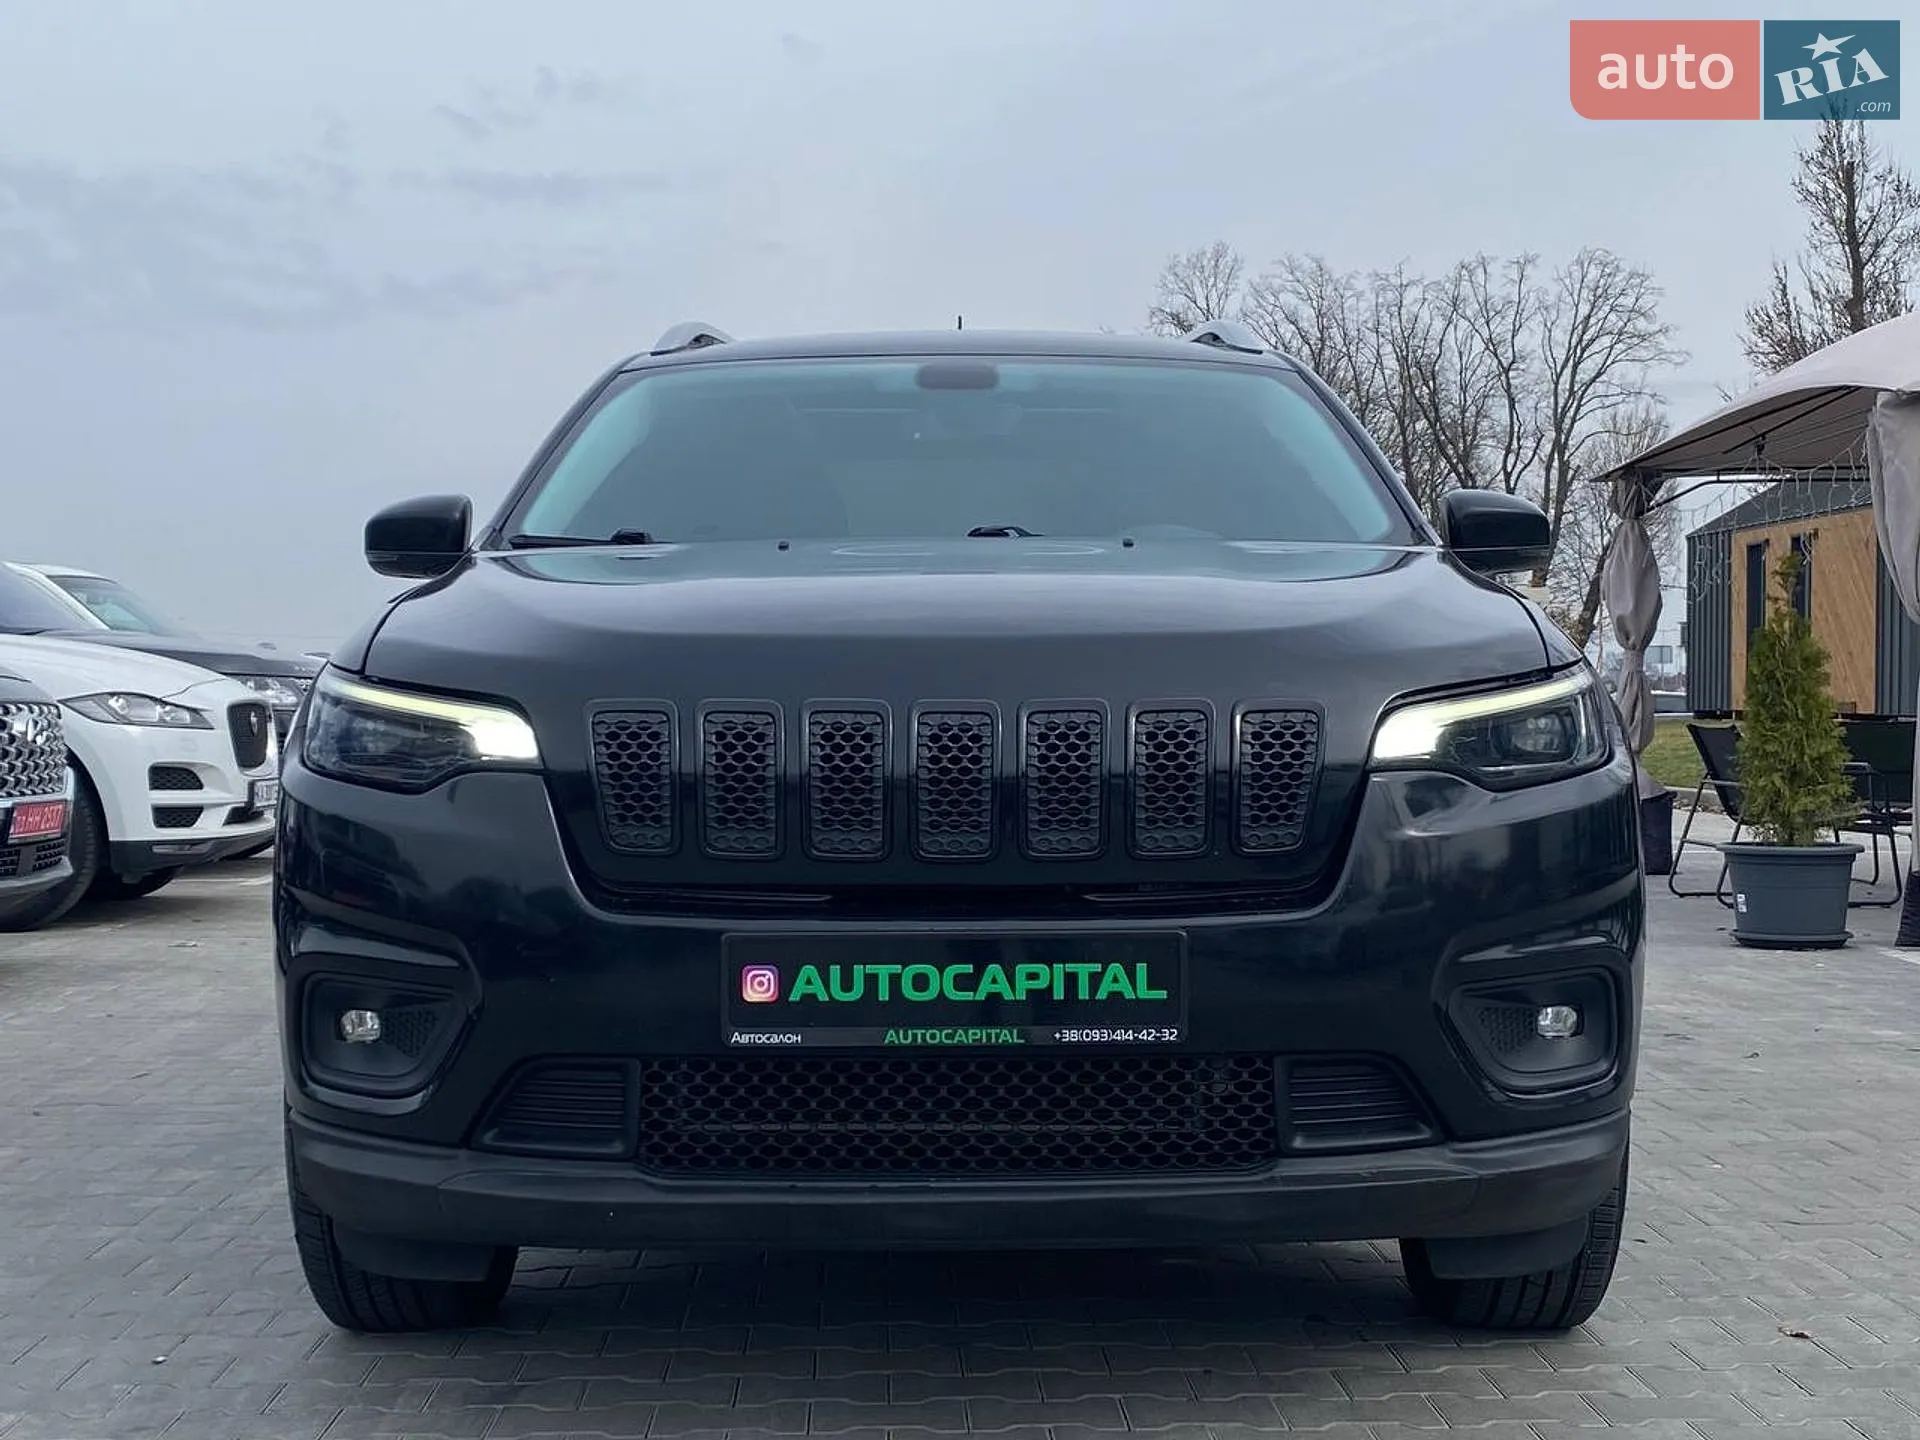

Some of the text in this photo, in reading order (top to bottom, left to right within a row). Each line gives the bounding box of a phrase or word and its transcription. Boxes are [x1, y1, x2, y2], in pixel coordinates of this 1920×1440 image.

[788, 963, 1168, 1001] AUTOCAPITAL
[730, 1031, 801, 1045] Автосалон
[883, 1028, 1026, 1045] AUTOCAPITAL
[1053, 1027, 1179, 1043] +38(093)414-42-32
